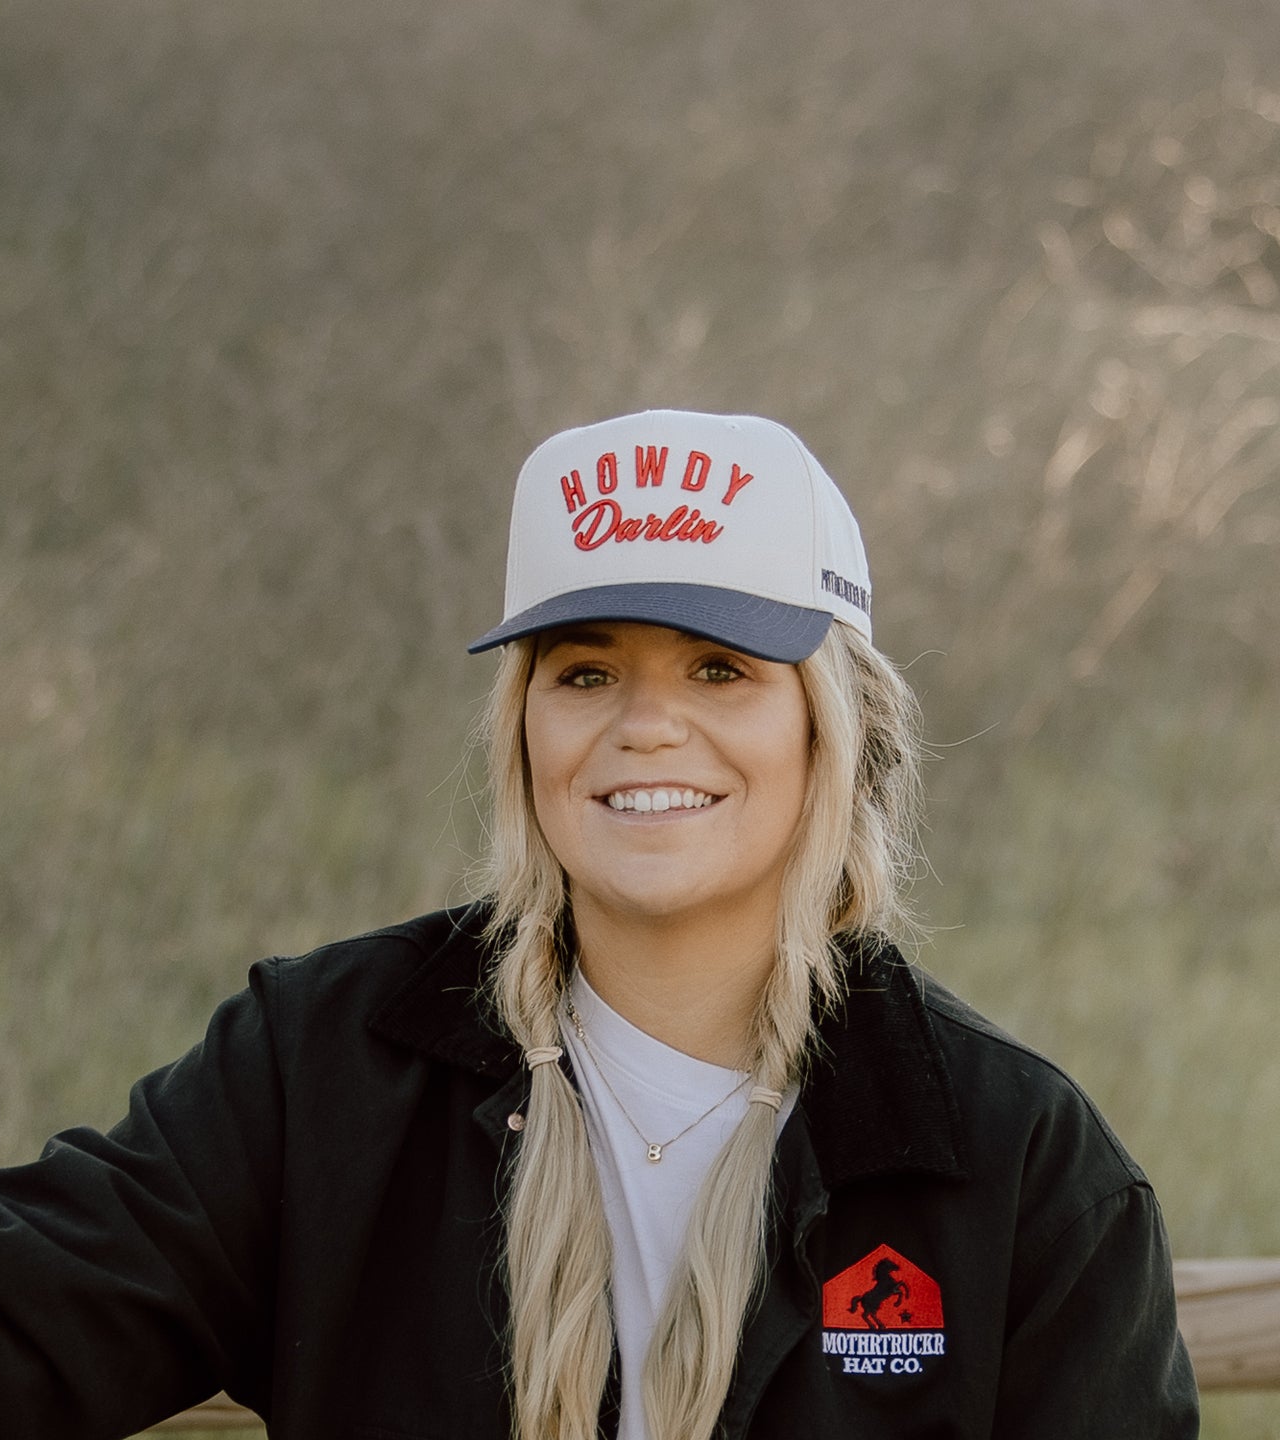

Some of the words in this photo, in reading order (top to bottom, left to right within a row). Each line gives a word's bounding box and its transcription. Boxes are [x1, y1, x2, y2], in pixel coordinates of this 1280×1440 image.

[560, 444, 754, 514] HOWDY
[571, 498, 724, 552] Darlin
[821, 1331, 946, 1356] MOTHRTRUCKR
[842, 1356, 886, 1374] HAT
[889, 1357, 924, 1374] CO.
